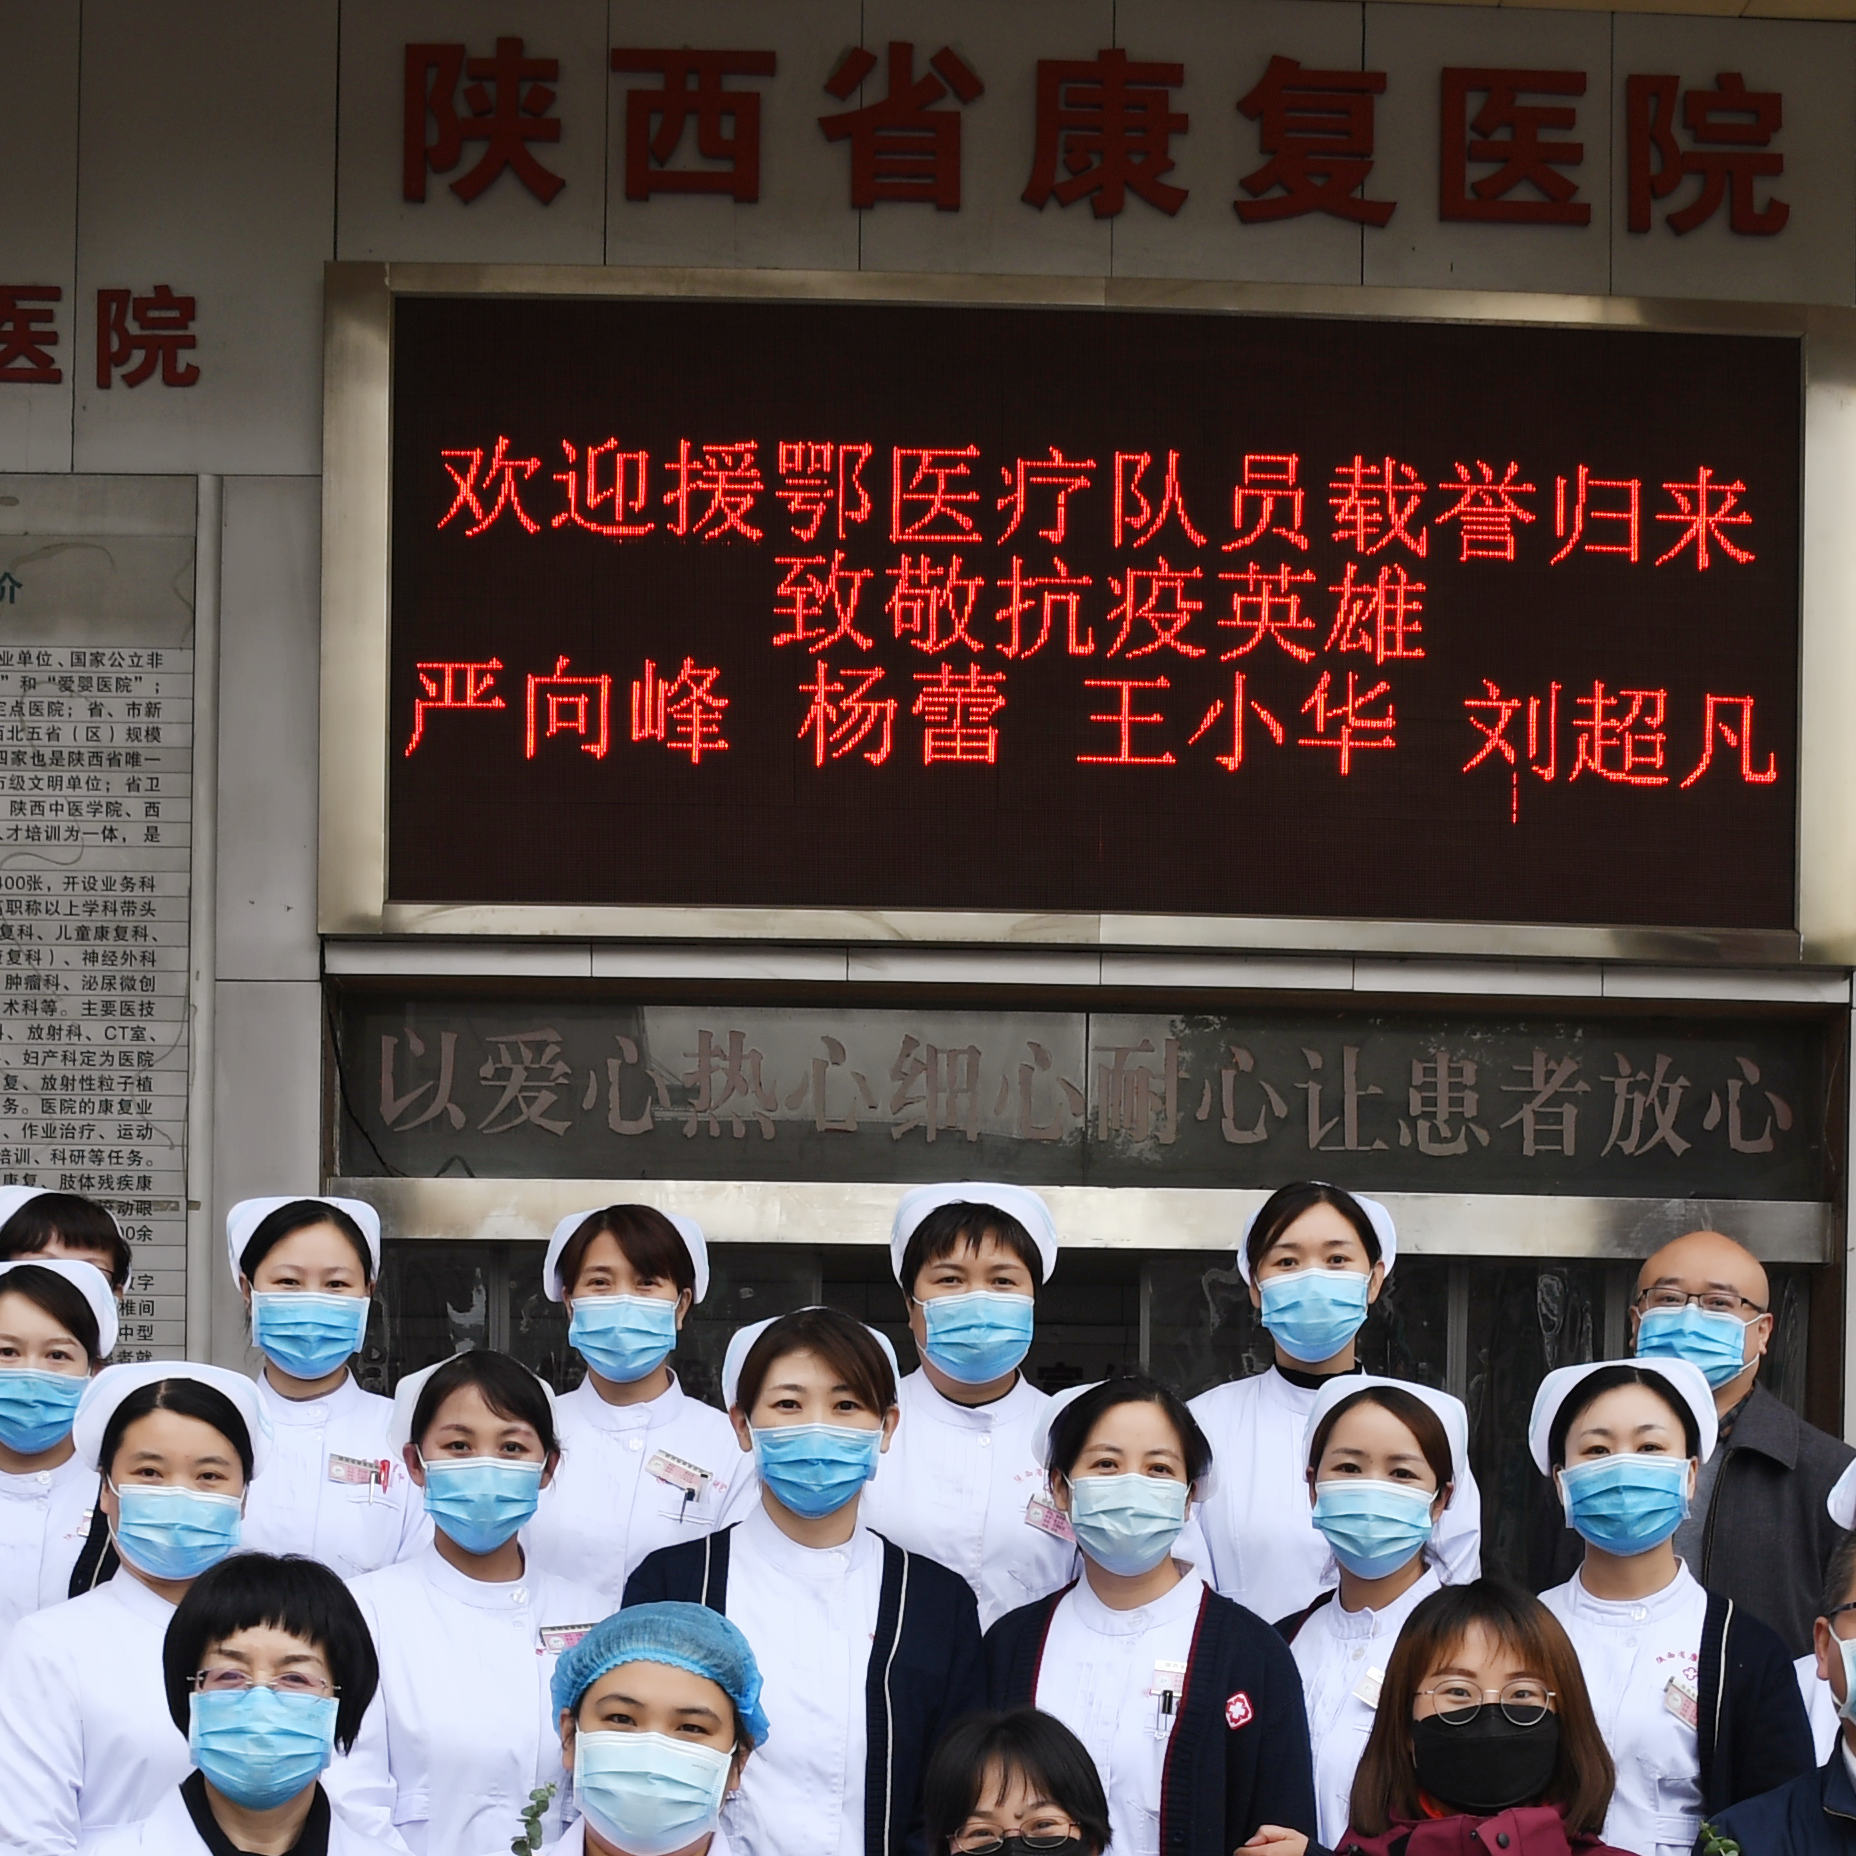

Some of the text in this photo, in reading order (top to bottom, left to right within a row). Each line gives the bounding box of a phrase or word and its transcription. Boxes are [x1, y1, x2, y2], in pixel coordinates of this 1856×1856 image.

[404, 37, 1790, 237] 陕西省康复医院
[438, 436, 1756, 571] 欢迎援鄂医疗队员载誉归来
[773, 549, 1426, 665] 致敬抗疫英雄
[404, 656, 1777, 788] 严向峰 杨蕾 王小华 刘超凡
[378, 1026, 1793, 1158] 以爱心热心细心耐心让患者放心
